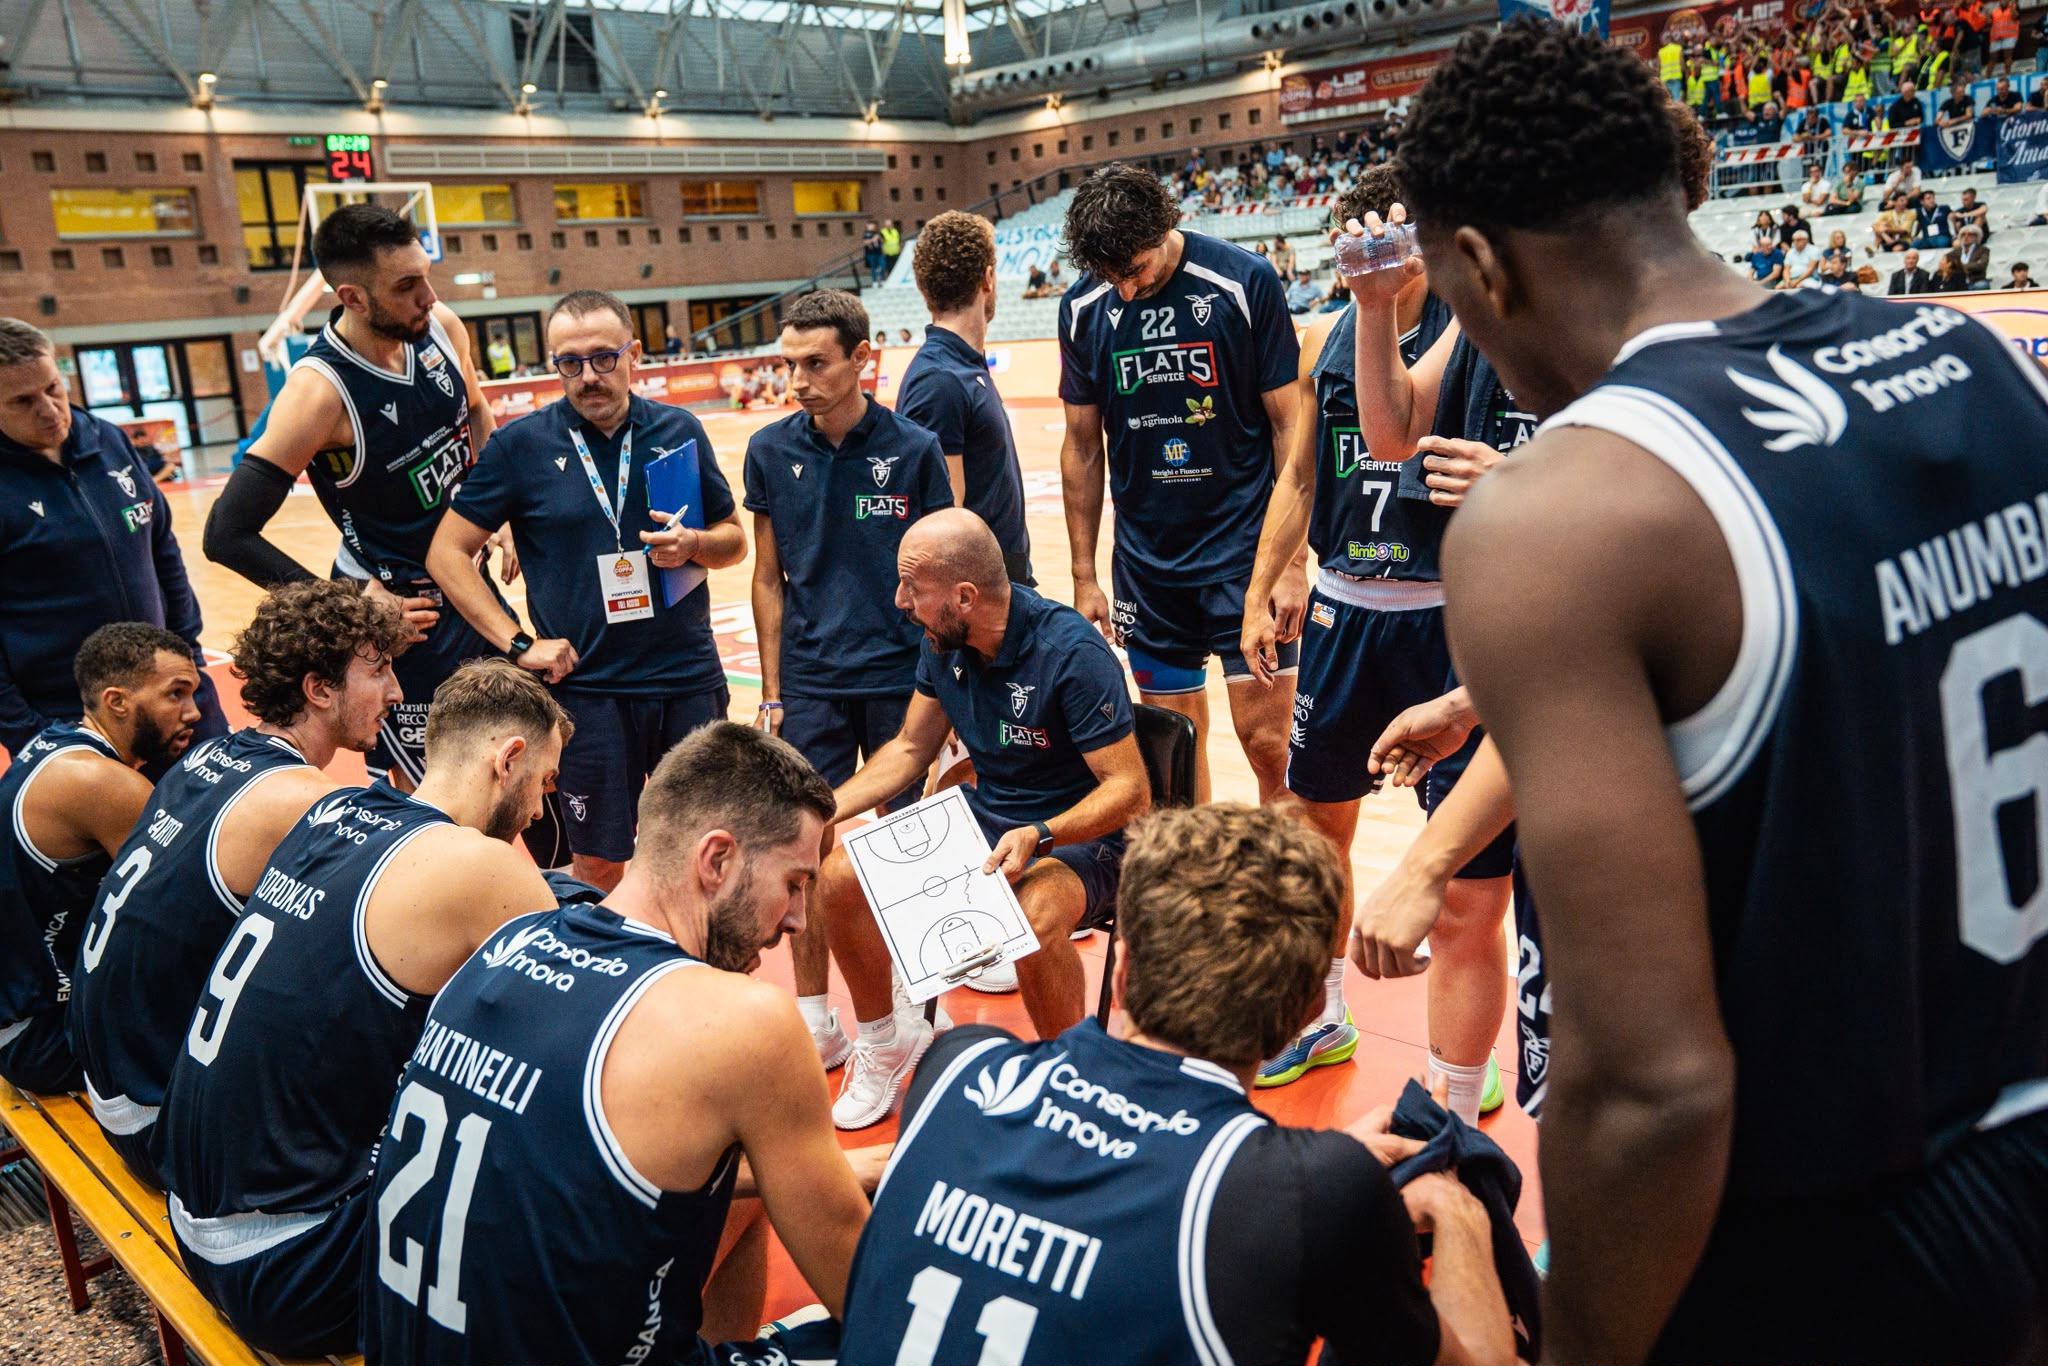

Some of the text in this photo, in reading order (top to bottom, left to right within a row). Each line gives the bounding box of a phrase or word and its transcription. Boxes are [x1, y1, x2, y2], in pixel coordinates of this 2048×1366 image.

[330, 151, 371, 178] 24
[1141, 306, 1176, 340] 22
[1812, 306, 1967, 375] Consorzio
[1119, 349, 1211, 389] FLATS
[1147, 372, 1185, 384] SERVICE
[1850, 354, 1973, 413] Innova
[1142, 415, 1184, 428] agrimola
[1163, 442, 1188, 461] MF
[859, 498, 906, 517] FLATS
[1362, 480, 1392, 533] 7
[1002, 724, 1047, 746] FLATS
[1939, 611, 2048, 966] 6
[83, 846, 153, 971] 3
[254, 867, 325, 921] SOROKAS
[530, 928, 628, 977] Consorzio
[188, 912, 275, 1067] 9
[1033, 1096, 1138, 1160] Innova
[378, 1080, 492, 1335] 21
[913, 1179, 1103, 1300] MORETTI
